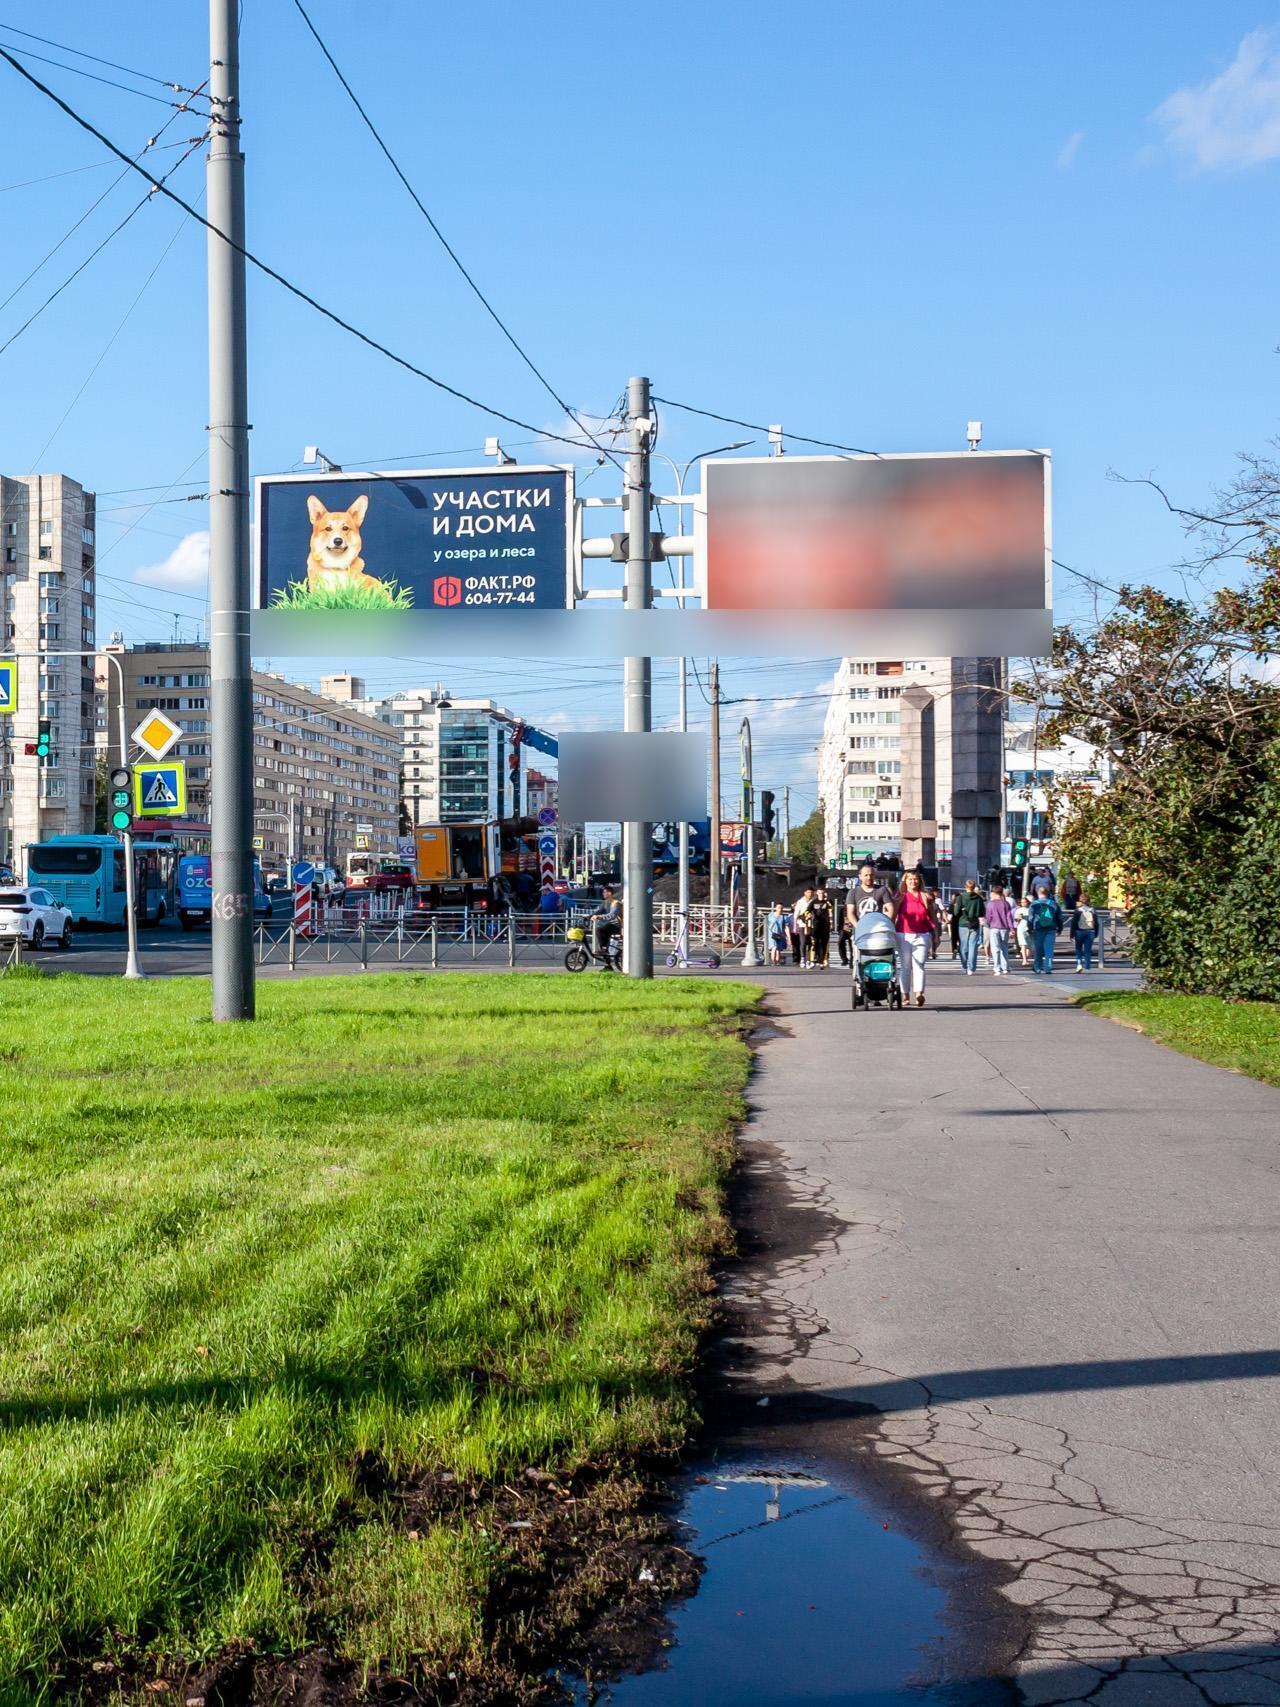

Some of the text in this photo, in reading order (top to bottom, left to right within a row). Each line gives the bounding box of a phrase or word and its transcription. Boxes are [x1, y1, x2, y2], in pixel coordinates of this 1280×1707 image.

[433, 488, 550, 511] УЧАСТКИ
[433, 513, 536, 538] И ДОМА
[433, 547, 536, 562] у озера и леса
[464, 575, 536, 590] ФАКТ.РФ
[464, 591, 536, 605] 604-77-44
